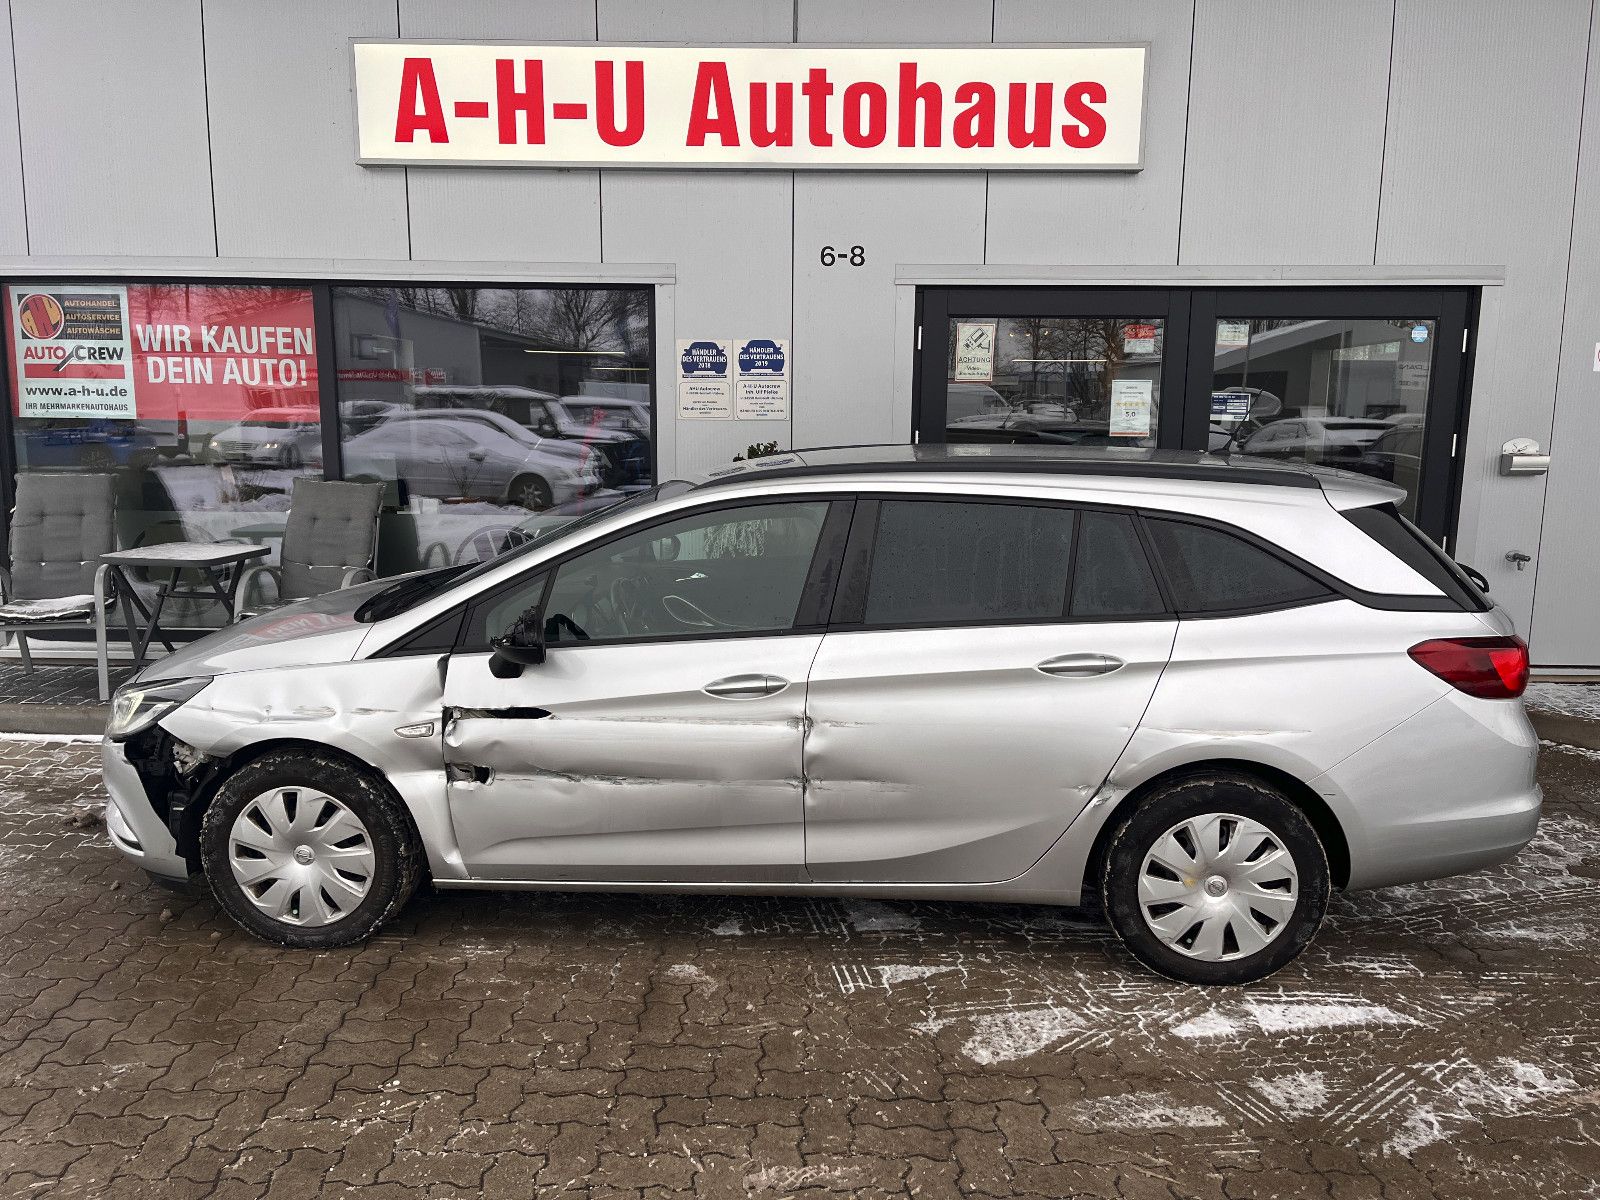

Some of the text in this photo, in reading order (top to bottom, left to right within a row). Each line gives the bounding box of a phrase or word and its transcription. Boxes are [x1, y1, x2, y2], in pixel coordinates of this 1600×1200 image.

[394, 57, 1107, 148] A-H-U Autohaus
[820, 245, 866, 267] 6-8
[66, 313, 120, 321] AUTOSERVICE
[66, 326, 121, 335] AUTOWÄSCHE
[136, 324, 313, 355] WIR KAUFEN
[24, 345, 124, 361] AUTO CREW
[691, 347, 717, 355] HÄNDLER
[682, 355, 727, 363] DES VERTRAUENS
[147, 356, 307, 387] DEIN AUTO!
[26, 385, 128, 397] www.a-h-u.de
[25, 402, 128, 411] IHR MEHRMARKENAUTOHAUS
